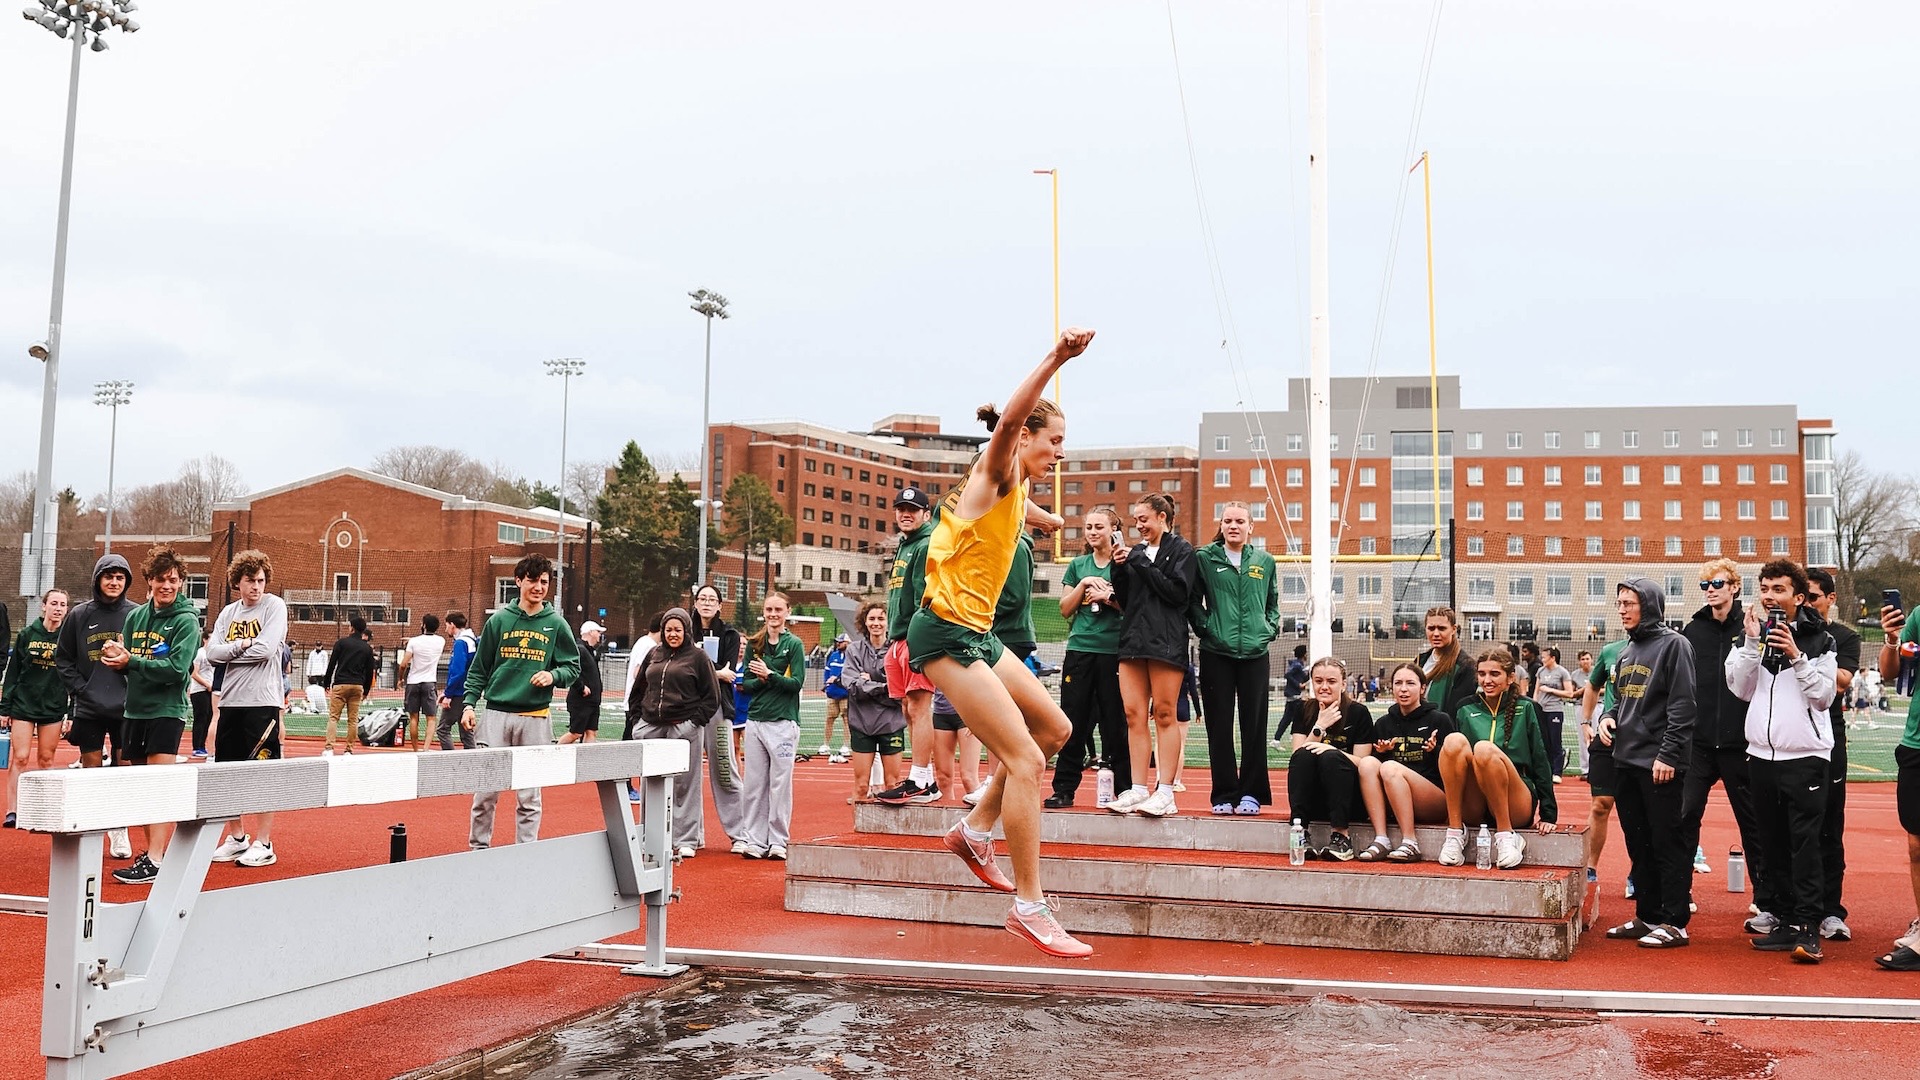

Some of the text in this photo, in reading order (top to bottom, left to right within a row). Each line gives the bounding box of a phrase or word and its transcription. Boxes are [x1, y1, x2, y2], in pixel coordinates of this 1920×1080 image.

[503, 630, 550, 644] BROCKPORT
[520, 648, 546, 656] COUNTRY
[716, 726, 731, 788] BROCKPORT
[83, 877, 95, 939] UCS
